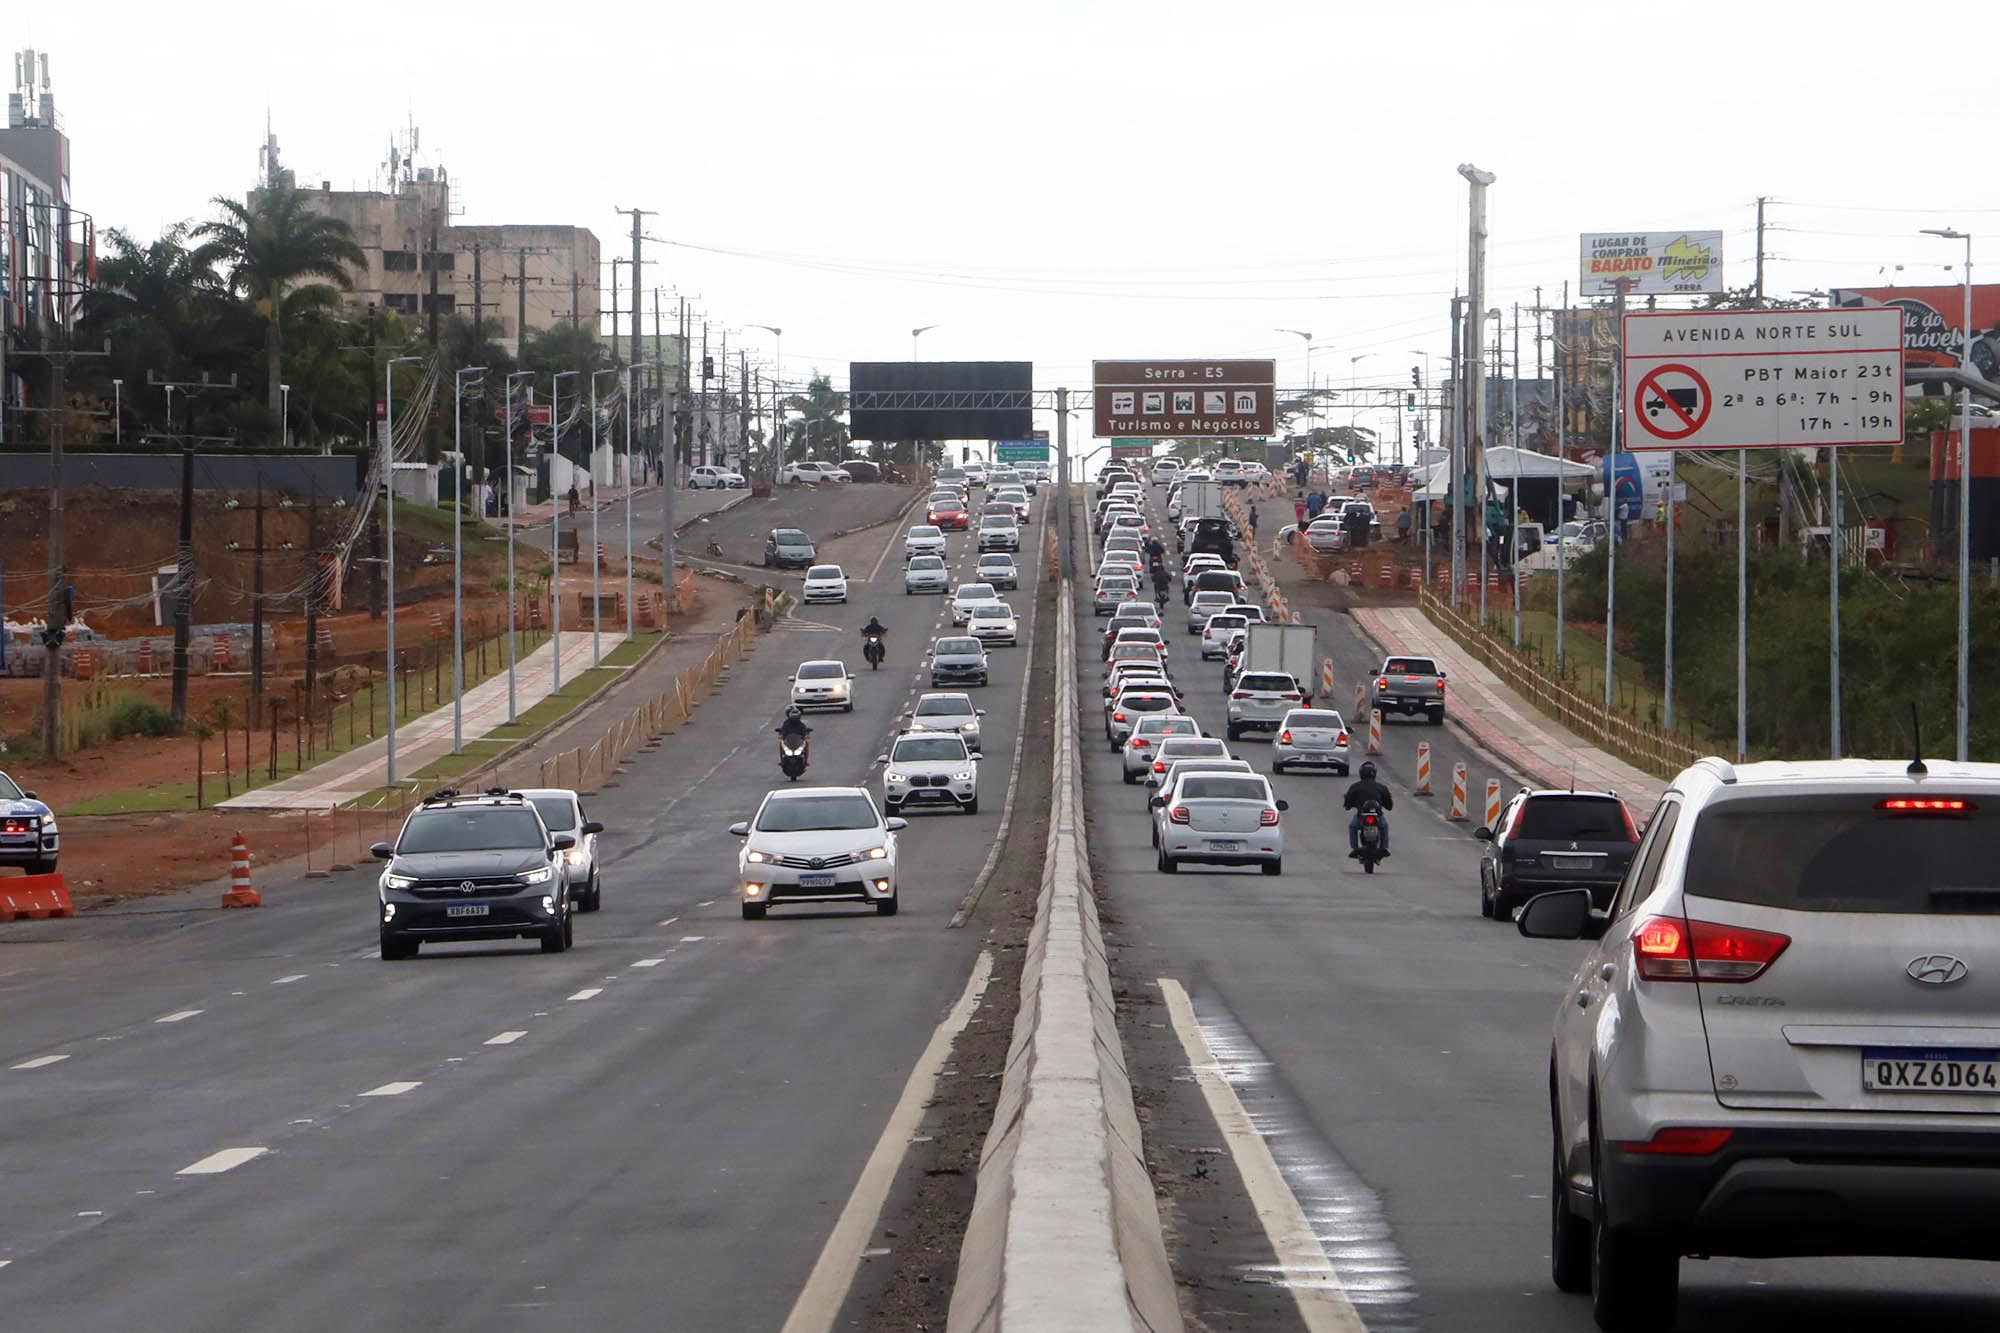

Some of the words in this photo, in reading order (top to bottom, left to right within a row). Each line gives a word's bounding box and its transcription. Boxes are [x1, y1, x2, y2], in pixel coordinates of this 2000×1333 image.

[1592, 237, 1629, 248] LUGAR
[1632, 236, 1647, 246] DE
[1592, 247, 1648, 258] COMPRAR
[1590, 256, 1653, 273] BARATO
[1922, 312, 1942, 328] do
[1663, 327, 1745, 342] AVENIDA
[1756, 325, 1816, 340] NORTE
[1828, 324, 1863, 338] SUL
[1144, 367, 1185, 378] Serra
[1205, 367, 1224, 378] ES
[1744, 368, 1783, 381] PBT
[1795, 367, 1848, 380] Maior
[1857, 365, 1892, 378] 23t
[1755, 396, 1765, 406] a
[1816, 392, 1839, 405] 7h
[1869, 390, 1892, 403] 9h
[1108, 419, 1171, 431] Turismo
[1178, 422, 1185, 430] e
[1191, 417, 1261, 432] Negócios
[1801, 417, 1832, 430] 17h
[1861, 416, 1892, 429] 19h
[1877, 1061, 1997, 1088] QXZ6D64
